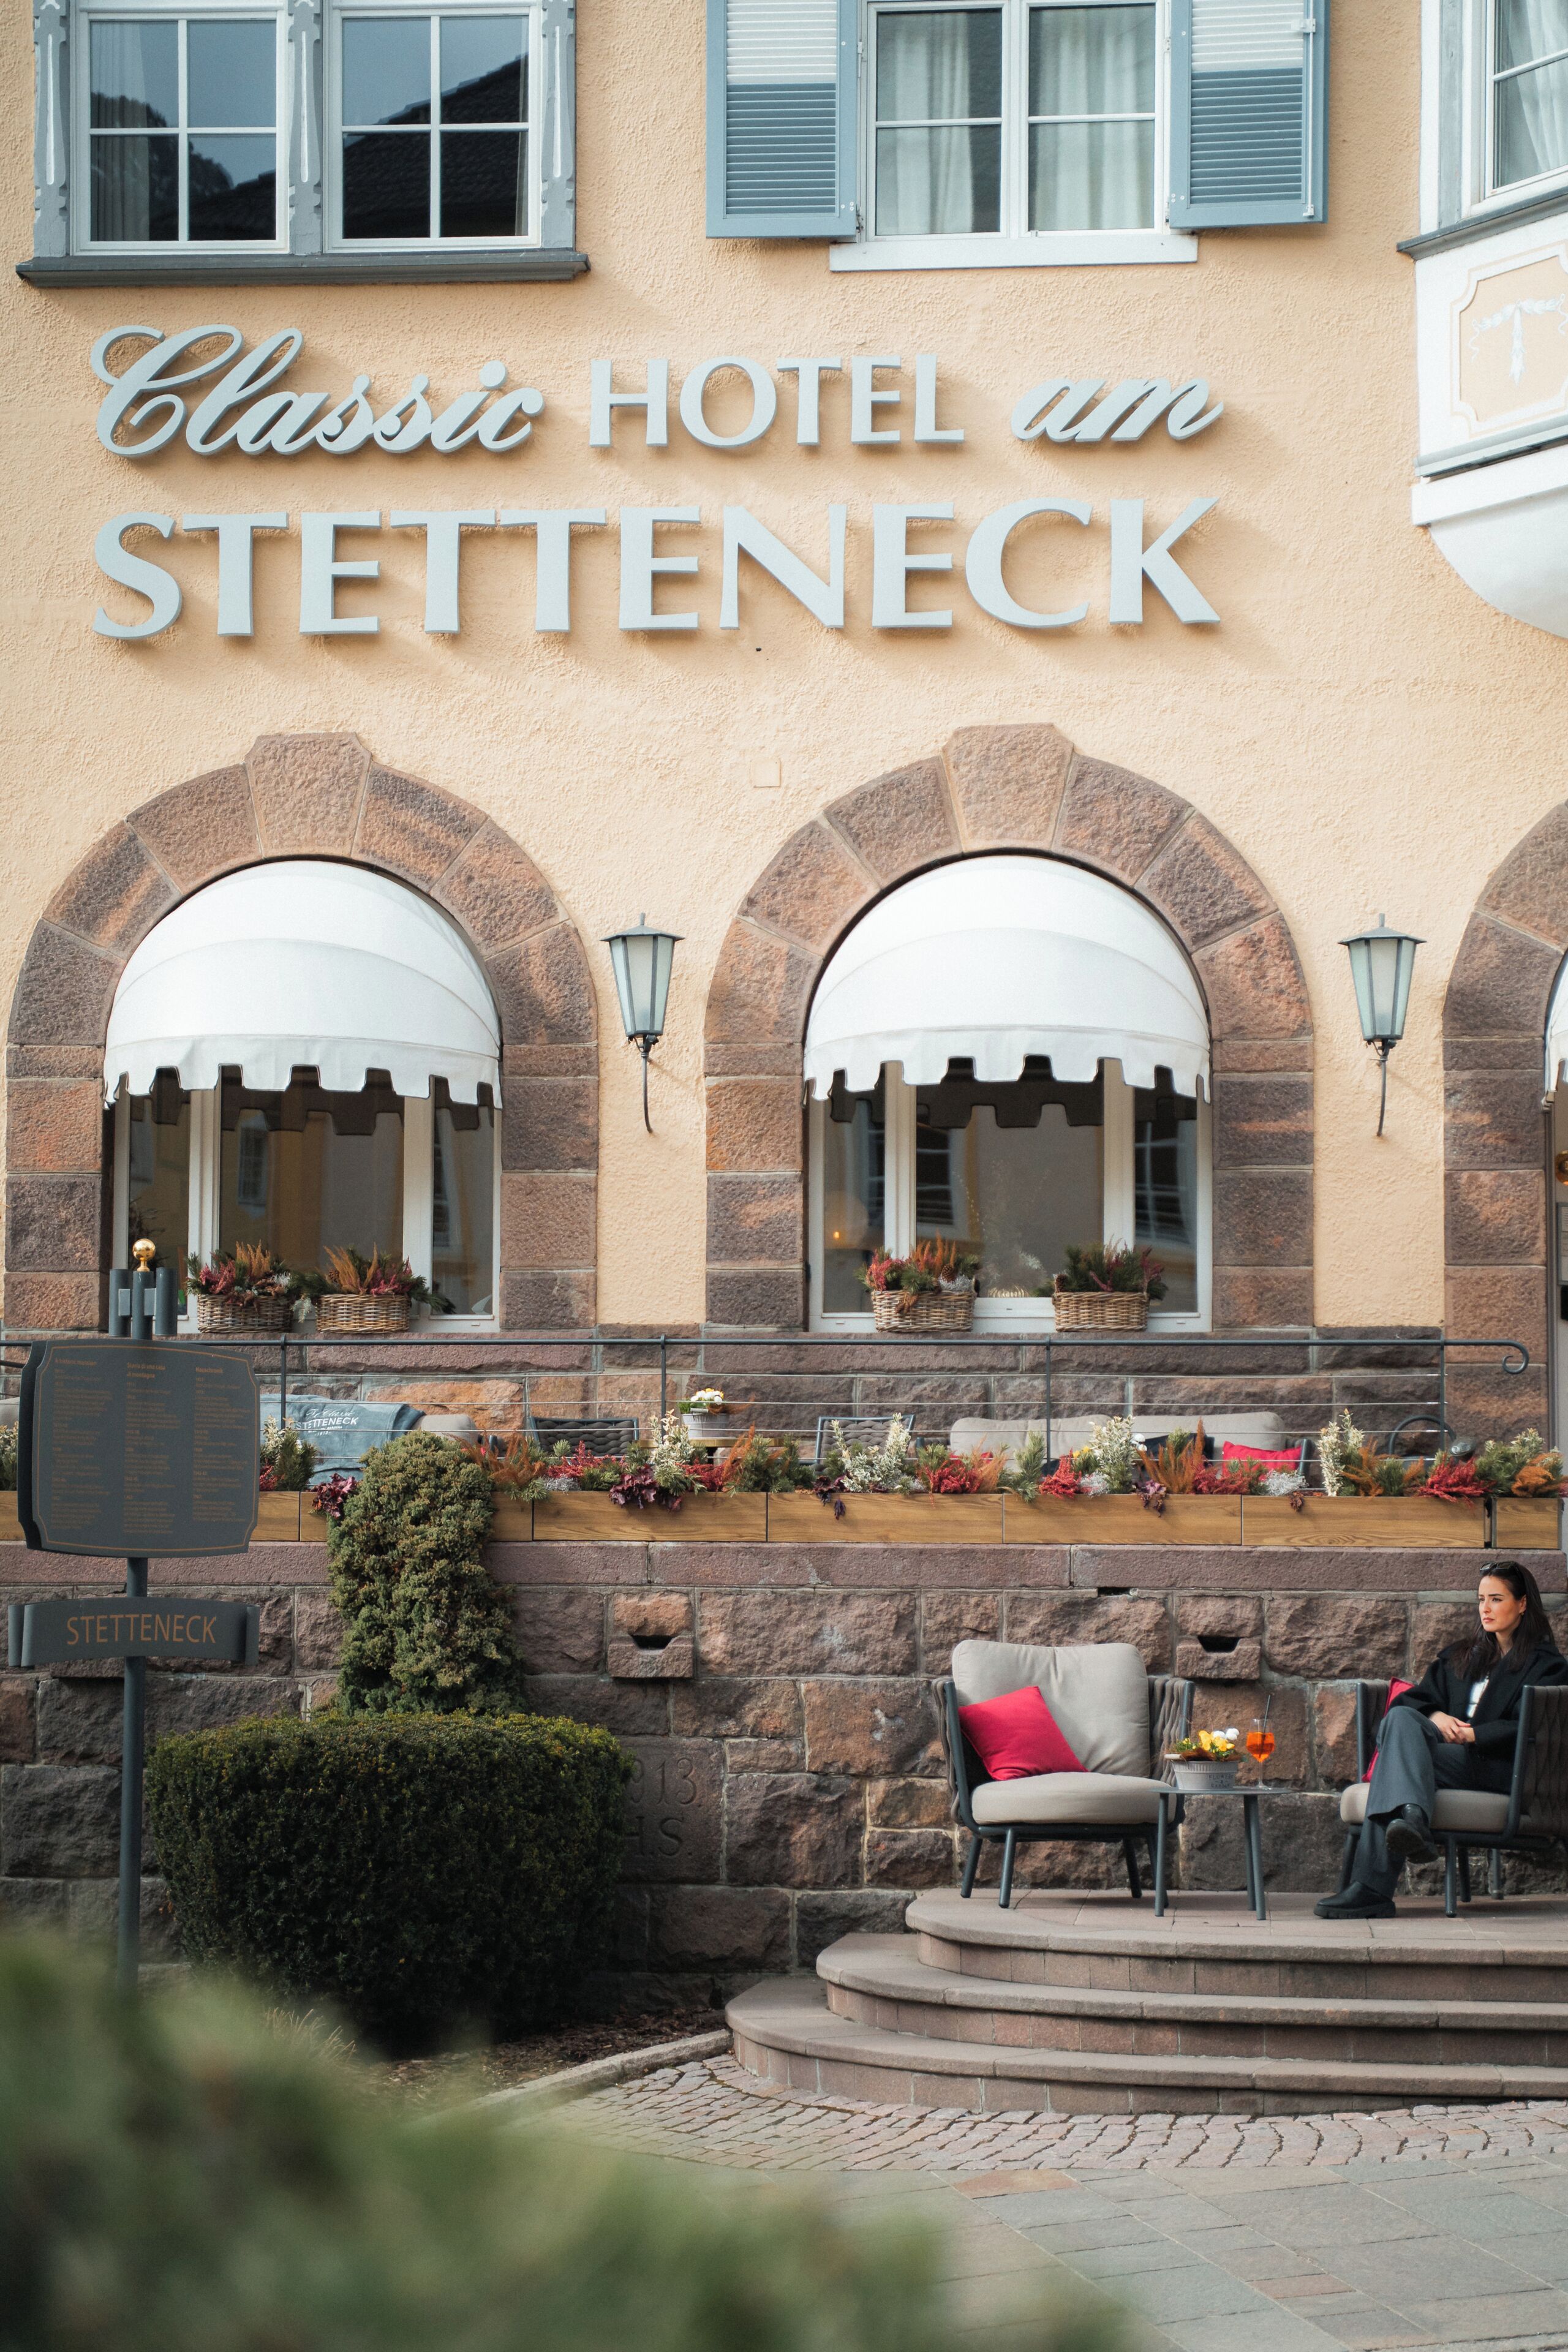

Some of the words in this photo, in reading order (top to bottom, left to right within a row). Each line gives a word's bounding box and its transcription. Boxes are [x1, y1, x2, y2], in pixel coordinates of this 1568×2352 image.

[91, 324, 545, 458] Classic
[589, 353, 965, 448] HOTEL
[1011, 378, 1224, 442] am
[91, 497, 1220, 641] STETTENECK
[296, 1417, 359, 1430] STETTENECK
[67, 1613, 217, 1645] STETTENECK
